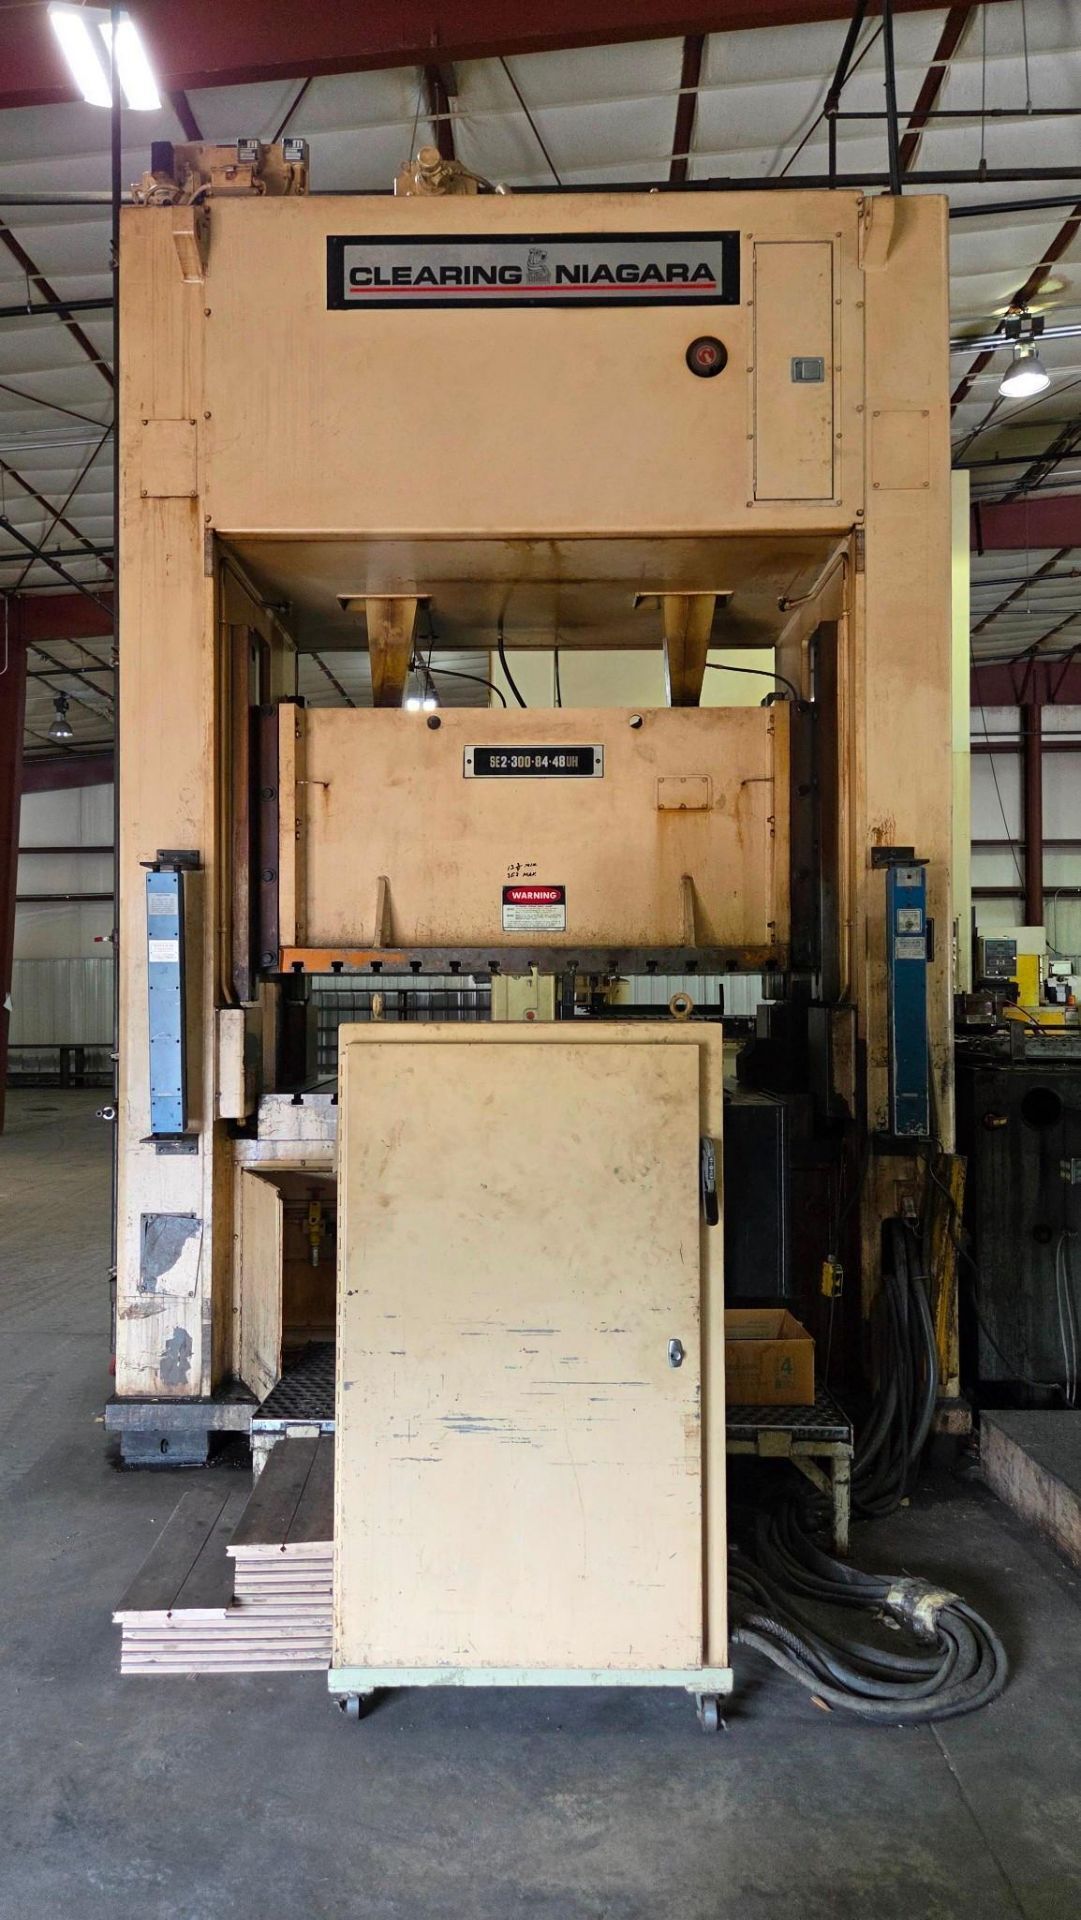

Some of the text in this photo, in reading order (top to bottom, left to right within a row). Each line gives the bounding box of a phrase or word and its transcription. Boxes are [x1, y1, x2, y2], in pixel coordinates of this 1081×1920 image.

[349, 263, 717, 286] CLEARING NIAGARA
[512, 891, 557, 900] WARNING
